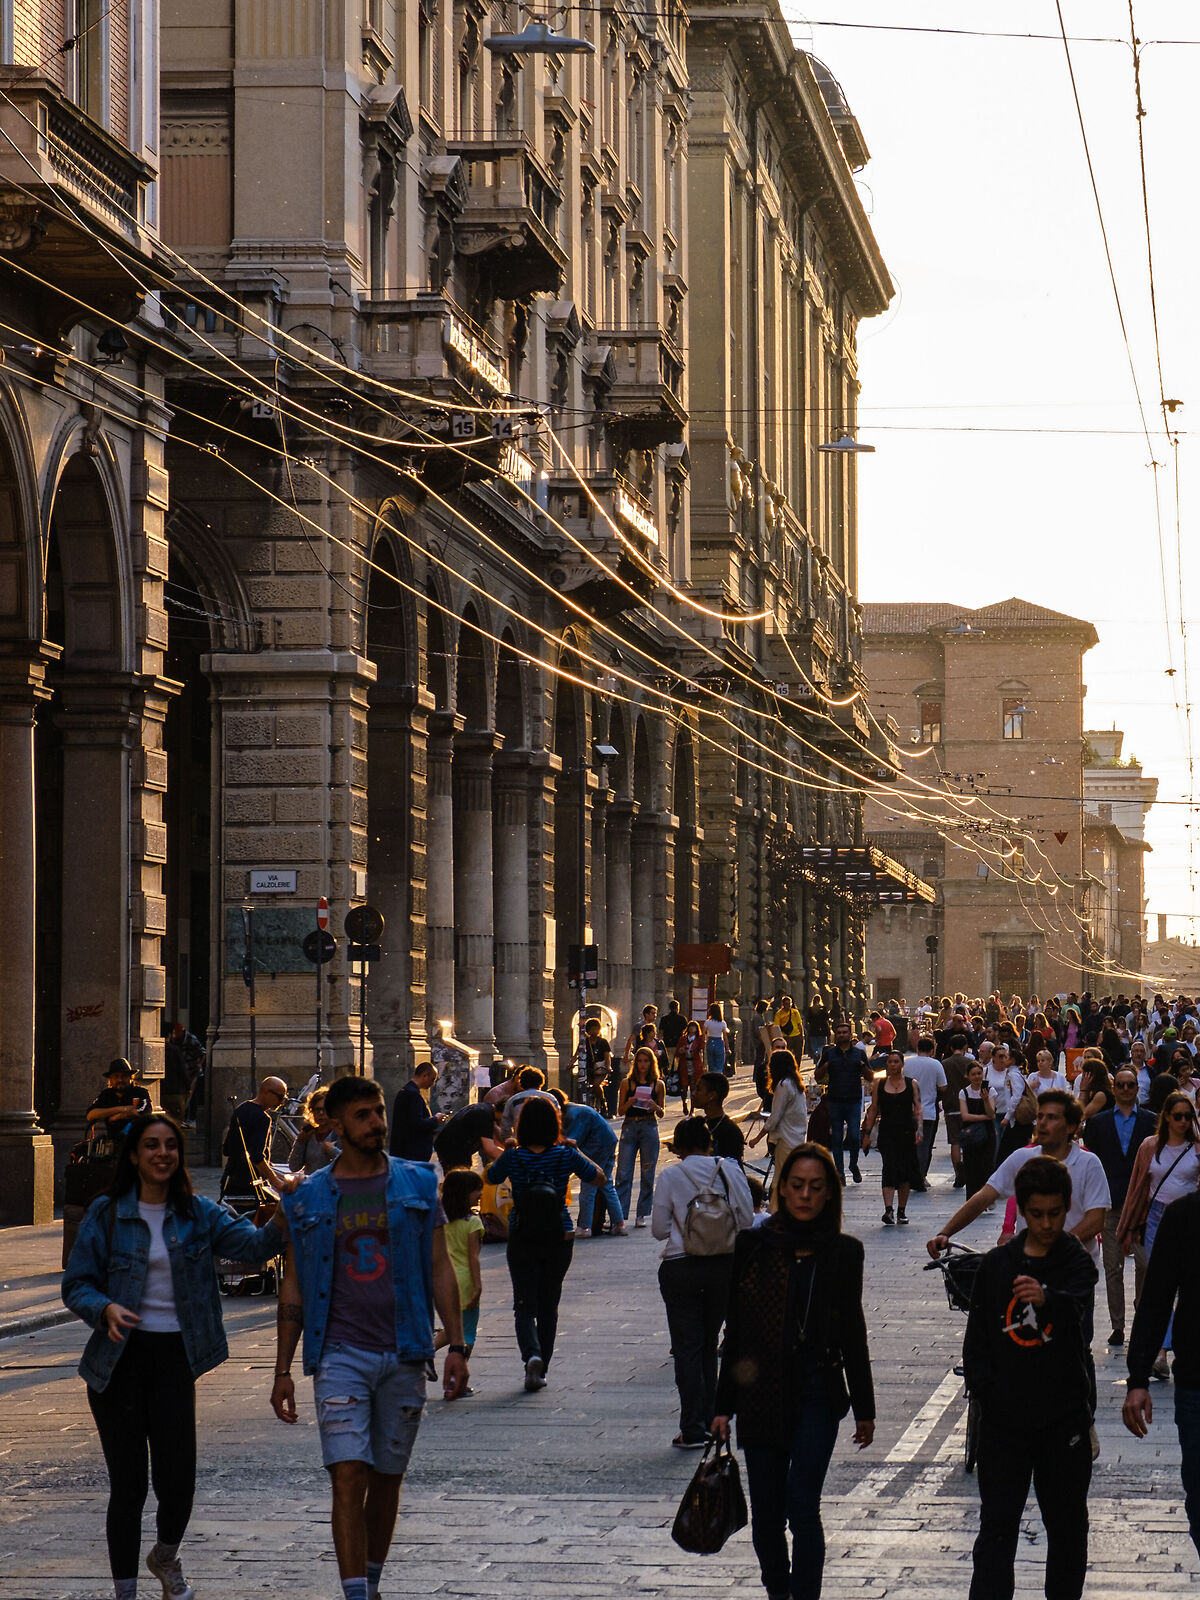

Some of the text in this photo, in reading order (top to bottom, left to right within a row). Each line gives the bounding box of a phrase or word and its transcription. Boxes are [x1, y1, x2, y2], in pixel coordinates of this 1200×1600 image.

[254, 402, 274, 415] 13
[454, 421, 474, 435] 15
[492, 422, 513, 436] 14
[777, 687, 788, 695] 15
[799, 687, 810, 695] 14
[255, 881, 291, 889] CALZOLERIE
